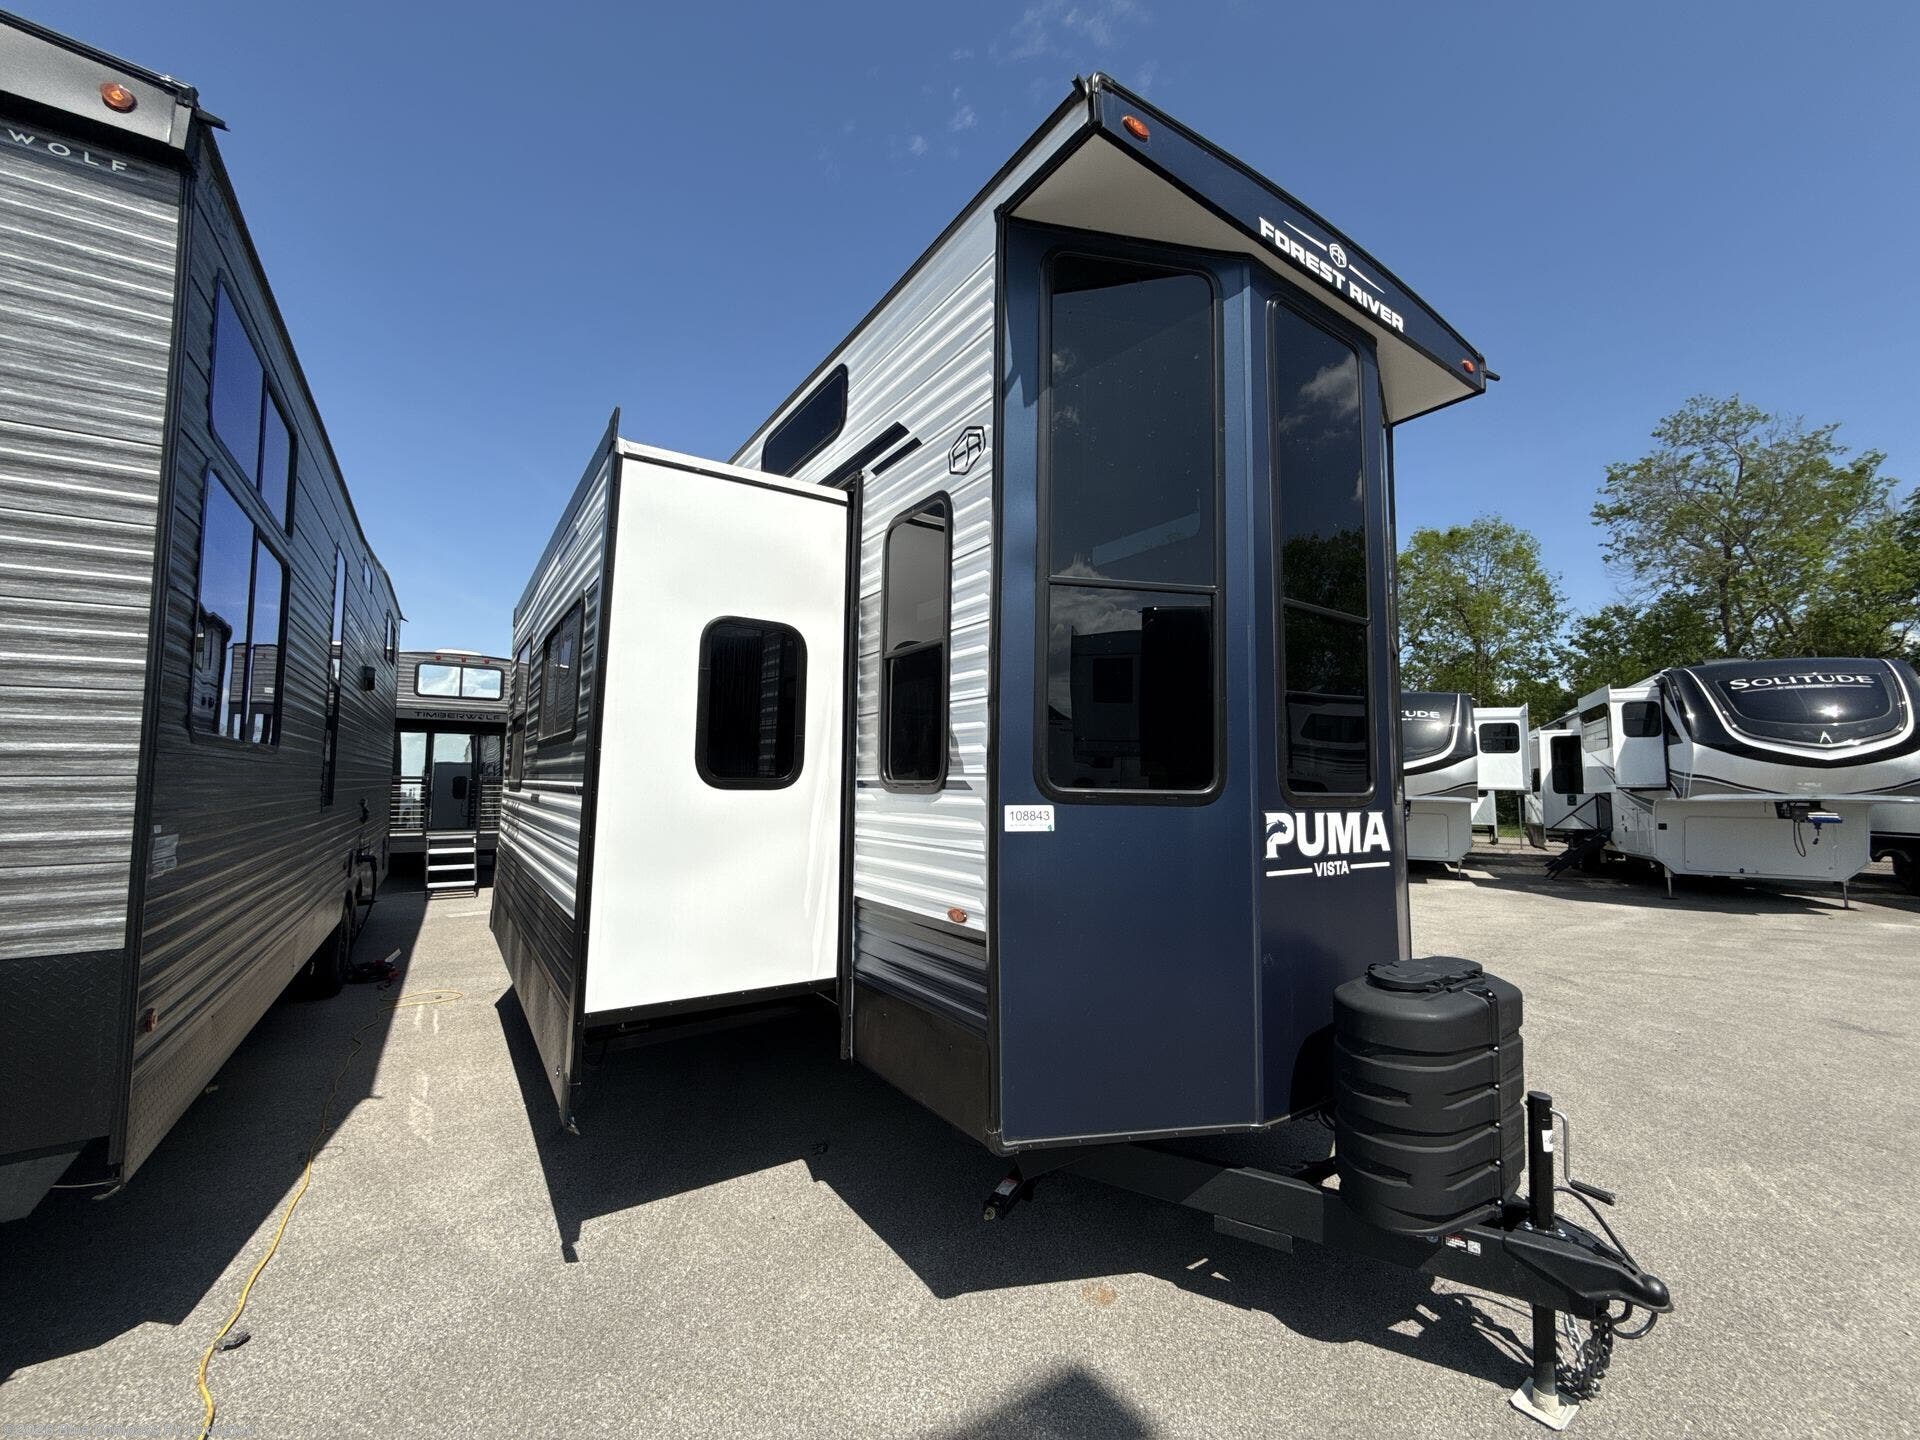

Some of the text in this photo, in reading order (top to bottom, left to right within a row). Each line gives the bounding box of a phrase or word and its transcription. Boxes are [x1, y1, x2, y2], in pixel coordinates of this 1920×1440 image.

[7, 128, 128, 172] WOLF
[1258, 216, 1405, 333] FOREST RIVER
[1729, 675, 1875, 690] SOLITUDE
[414, 711, 501, 721] TIMBERWOLF
[1009, 810, 1050, 822] 108843
[1264, 811, 1391, 858] PUMA
[1314, 860, 1350, 877] VISTA
